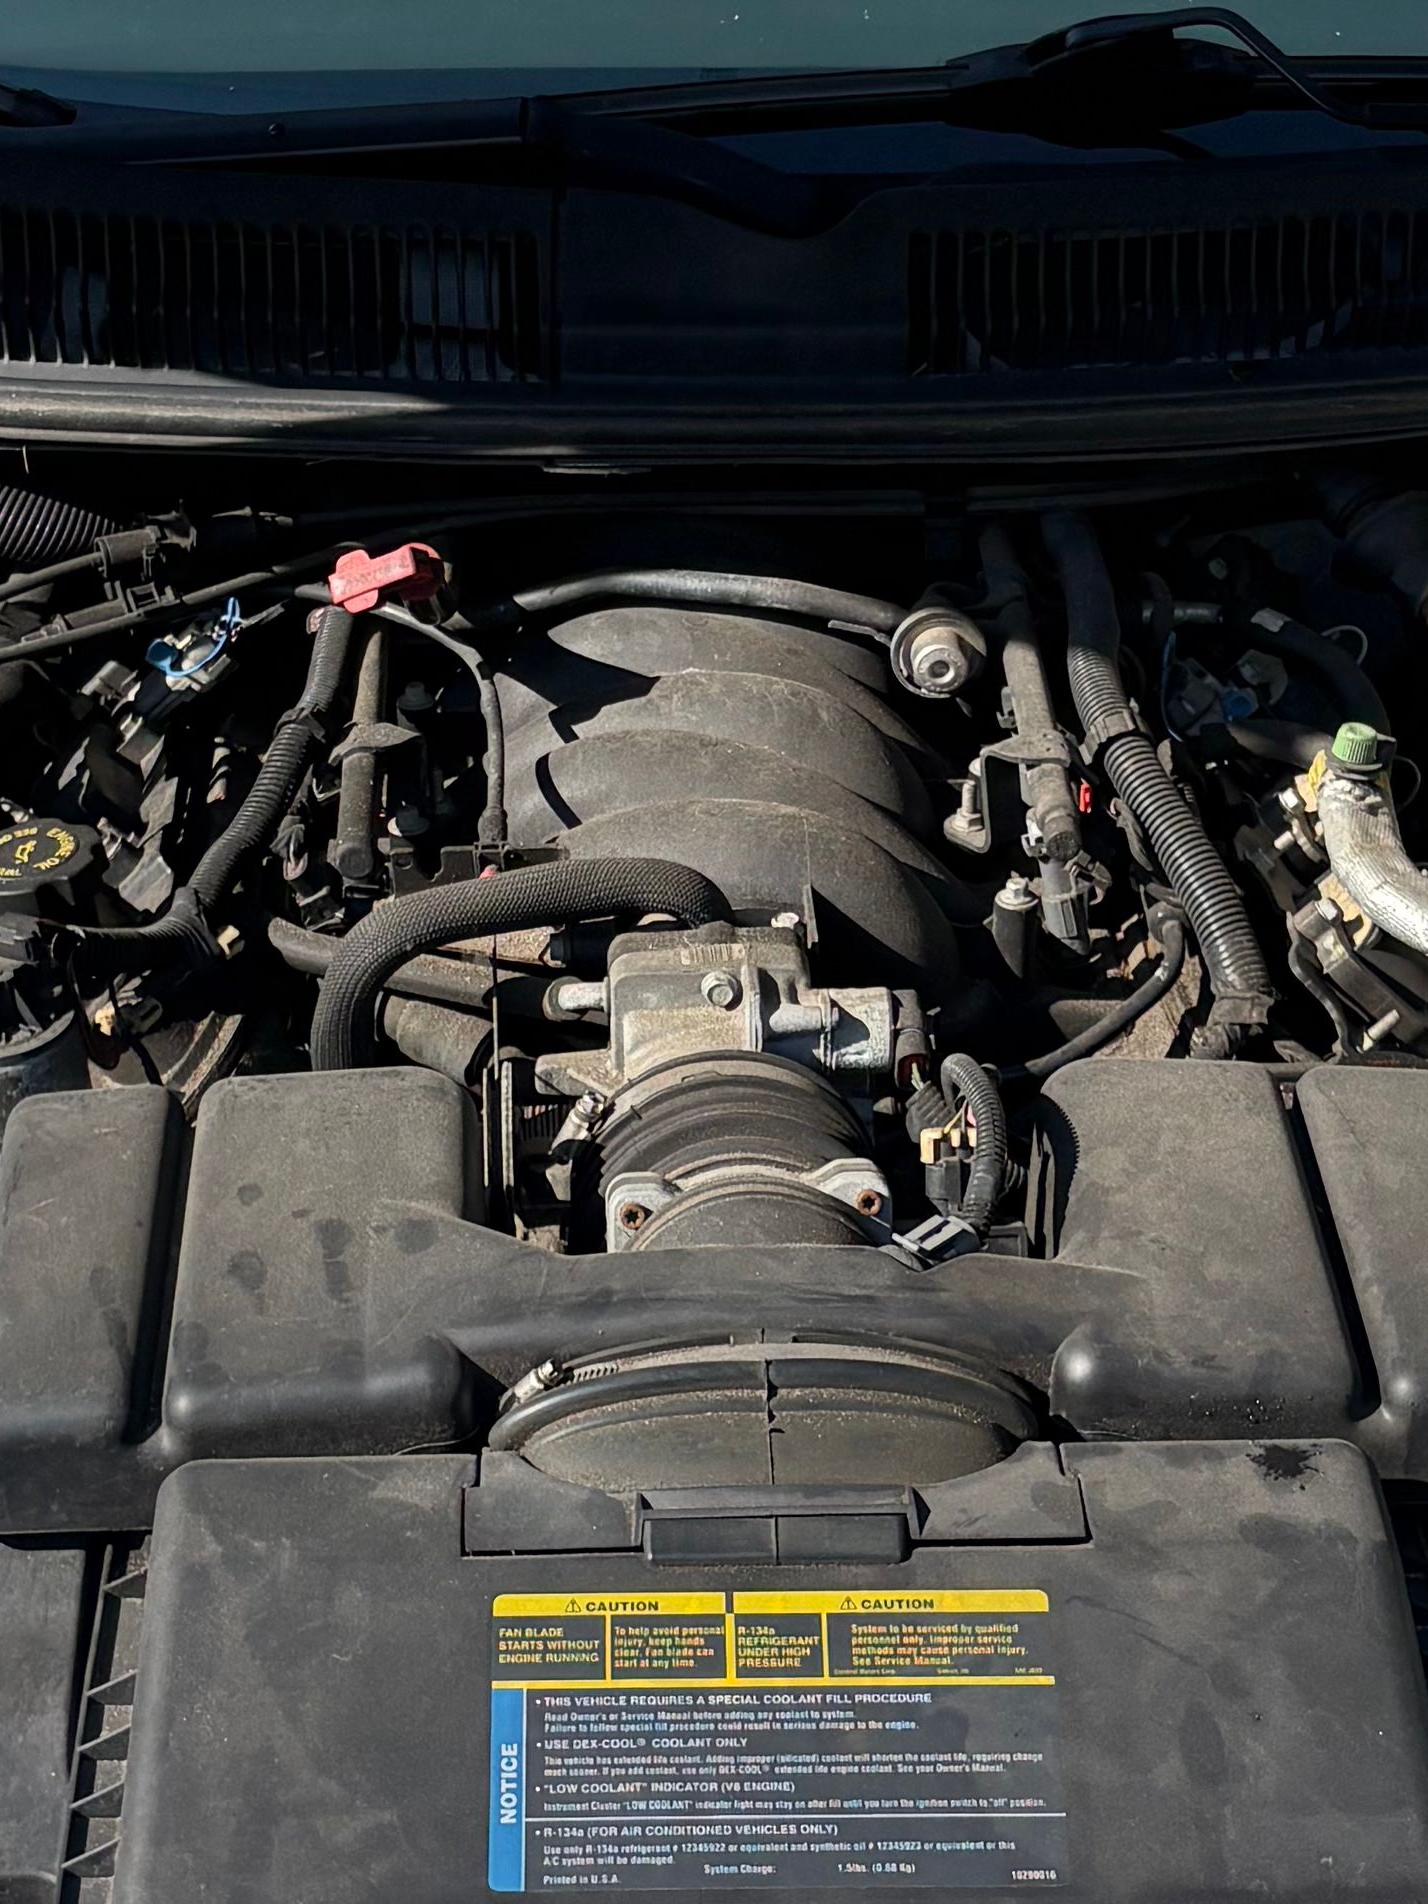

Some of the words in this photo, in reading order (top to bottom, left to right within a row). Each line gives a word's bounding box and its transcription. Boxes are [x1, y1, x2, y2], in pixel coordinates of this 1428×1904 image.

[46, 827, 76, 858] ENGINE
[32, 857, 61, 871] OIL
[585, 1601, 660, 1612] CAUTION
[860, 1599, 936, 1610] CAUTION
[499, 1628, 522, 1637] FAN
[524, 1628, 563, 1637] BLADE
[615, 1626, 626, 1635] To
[628, 1627, 649, 1636] help
[652, 1627, 679, 1635] avoid
[681, 1627, 724, 1636] personal
[851, 1624, 886, 1634] System
[889, 1624, 899, 1633] to
[902, 1624, 914, 1633] be
[916, 1625, 958, 1633] serviced
[960, 1624, 972, 1634] by
[974, 1624, 1018, 1633] qualified
[498, 1641, 543, 1650] STARTS
[546, 1640, 598, 1649] WITHOUT
[648, 1637, 672, 1649] keep
[674, 1637, 704, 1645] hands
[738, 1636, 821, 1646] REFRIGERANT
[851, 1636, 900, 1645] personnel
[929, 1636, 974, 1644] Improper
[976, 1636, 1012, 1644] service
[645, 1647, 663, 1656] Fan
[666, 1648, 694, 1656] blade
[738, 1647, 778, 1656] UNDER
[781, 1647, 810, 1656] HIGH
[852, 1647, 894, 1655] methods
[896, 1647, 917, 1658] may
[920, 1646, 950, 1654] cause
[498, 1654, 542, 1663] ENGINE
[545, 1653, 598, 1662] RUNNING
[738, 1658, 800, 1667] PRESSURE
[852, 1656, 870, 1666] See
[874, 1656, 910, 1665] Service
[913, 1656, 954, 1665] Manual.
[614, 1659, 637, 1667] start
[639, 1659, 649, 1667] at
[652, 1660, 668, 1669] any
[544, 1697, 571, 1706] THIS
[574, 1696, 626, 1706] VEHICLE
[630, 1696, 693, 1705] REQUIRES
[696, 1696, 704, 1704] A
[708, 1695, 760, 1705] SPECIAL
[763, 1694, 821, 1704] COOLANT
[826, 1694, 851, 1703] FILL
[854, 1693, 931, 1703] PROCEDURE
[544, 1740, 569, 1749] USE
[651, 1738, 710, 1748] COOLANT
[715, 1738, 746, 1747] ONLY
[500, 1742, 518, 1825] NOTICE
[544, 1784, 578, 1794] "LOW
[580, 1782, 647, 1793] COOLANT"
[650, 1782, 718, 1792] INDICATOR
[743, 1782, 794, 1791] ENGINE)
[587, 1826, 617, 1838] (FOR
[620, 1826, 642, 1836] AIR
[645, 1825, 732, 1836] CONDITIONED
[735, 1825, 796, 1834] VEHICLES
[800, 1824, 838, 1835] ONLY)
[704, 1864, 738, 1875] System
[740, 1864, 775, 1874] Charge:
[543, 1875, 576, 1884] Printed
[579, 1876, 588, 1884] in
